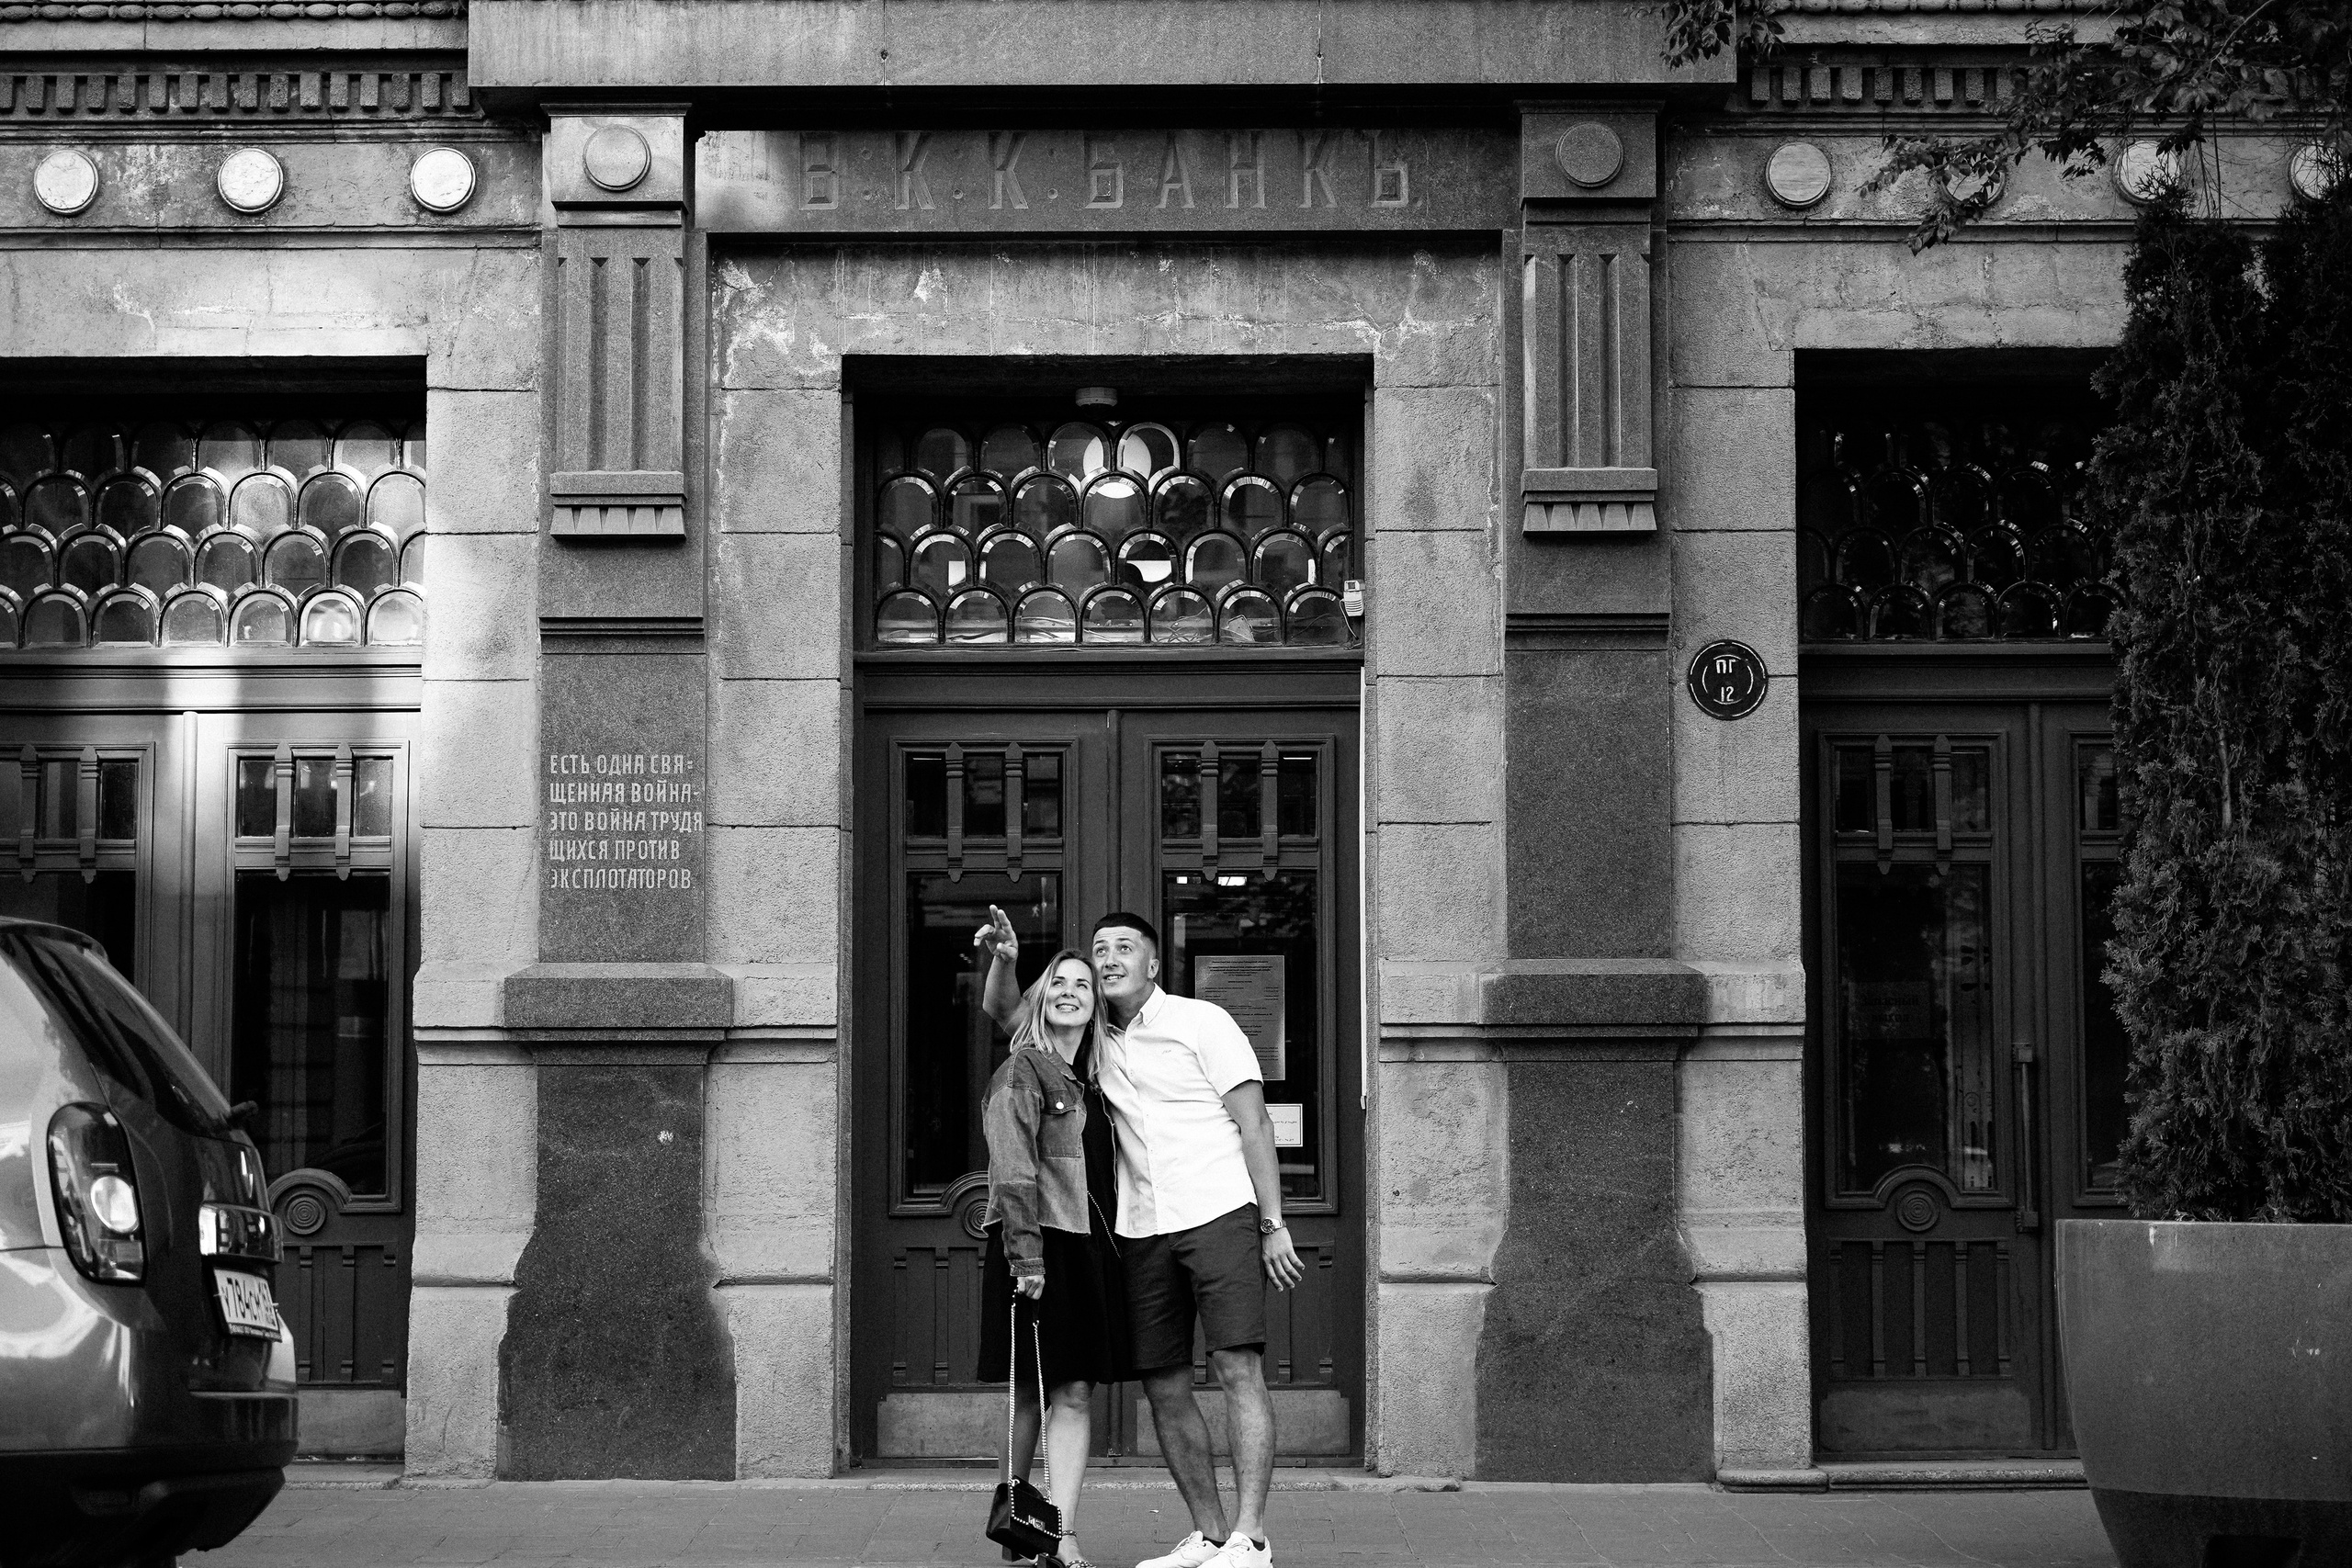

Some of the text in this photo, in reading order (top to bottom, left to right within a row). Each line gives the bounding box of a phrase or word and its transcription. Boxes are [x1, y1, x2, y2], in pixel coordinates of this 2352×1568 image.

[1715, 659, 1737, 674] ПГ
[1721, 686, 1735, 703] 12
[549, 754, 590, 774] ЕСТЬ
[596, 754, 644, 776] ОДНА
[549, 783, 625, 804] ЩЕННАЯ
[549, 808, 703, 832] ЭТО ВОЙНА ТРУДЯ
[549, 840, 680, 862] ЩИХСЯ ПРОТИВ
